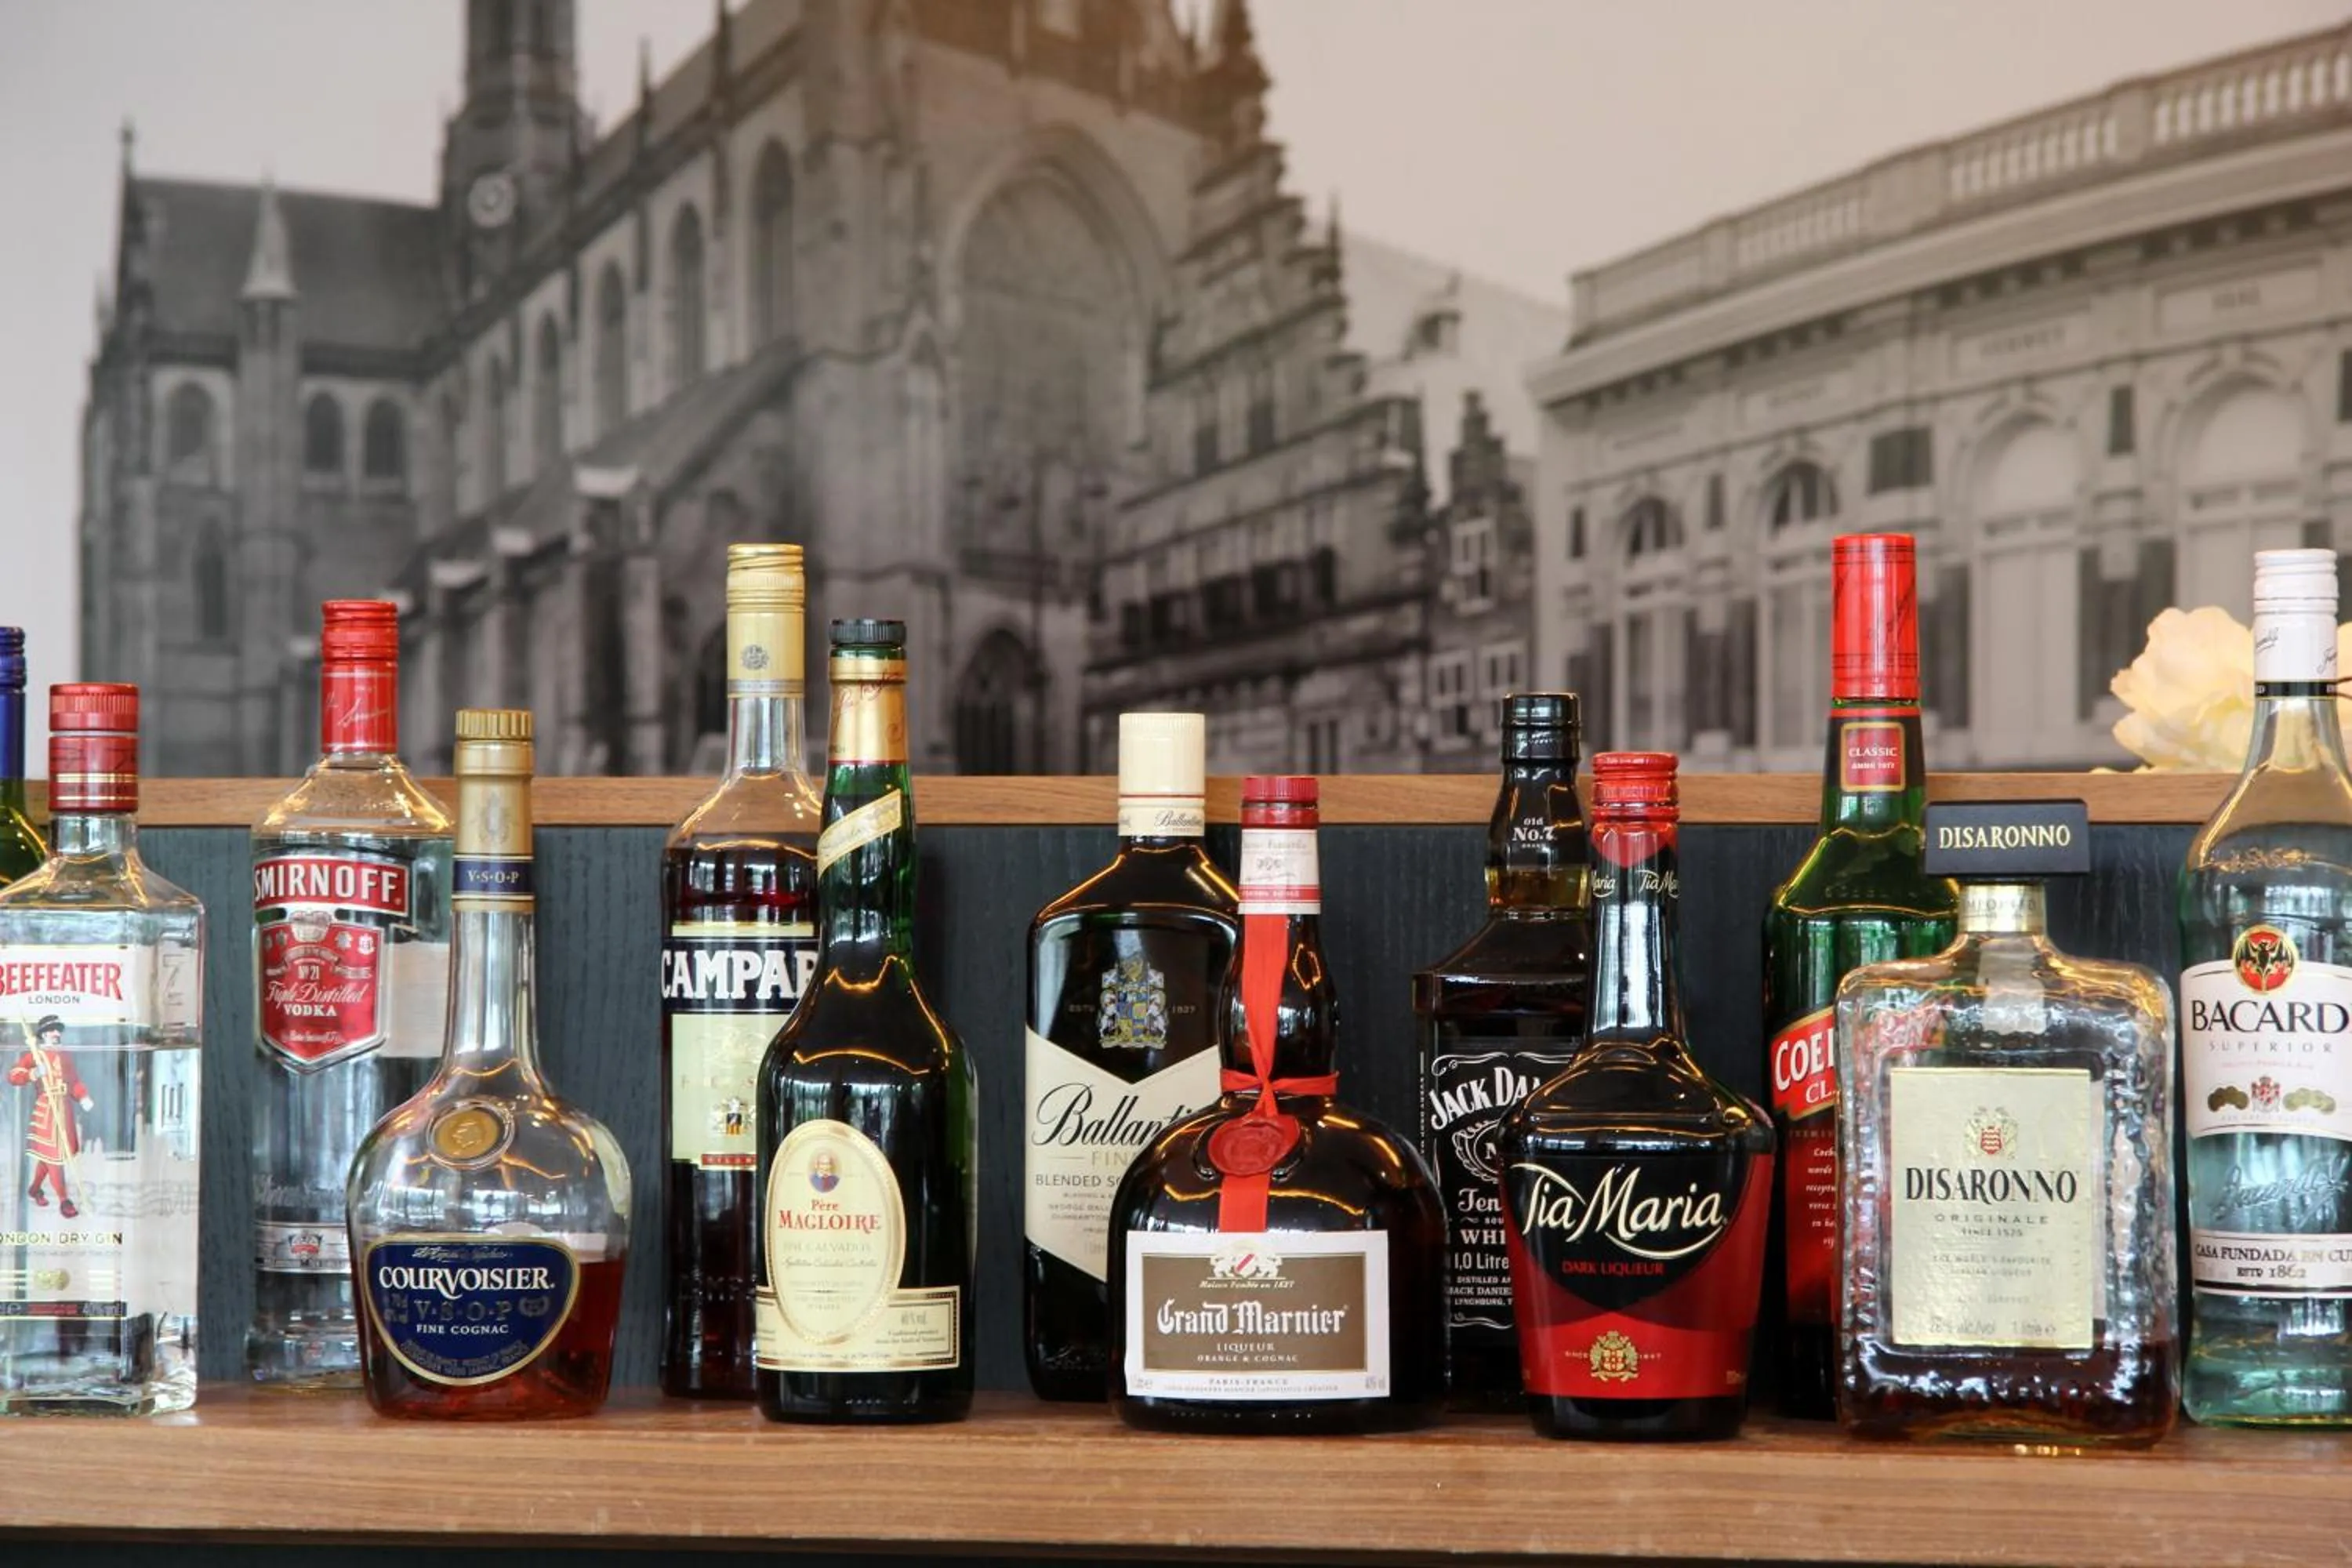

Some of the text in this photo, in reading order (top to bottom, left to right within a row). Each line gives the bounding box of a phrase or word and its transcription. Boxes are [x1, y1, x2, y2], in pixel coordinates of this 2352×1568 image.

[1849, 746, 1898, 757] CLASSIC
[1939, 825, 2071, 850] DISARONNO
[255, 863, 398, 903] SMIRNOFF
[1635, 869, 1659, 893] Tia
[27, 995, 81, 1004] LONDON
[294, 982, 369, 1003] Distilled
[284, 1004, 336, 1017] VODKA
[2191, 1000, 2352, 1033] BACARD
[2209, 1042, 2332, 1053] SUPERIOR
[1428, 1077, 1493, 1130] JACK
[1092, 1151, 1137, 1166] FIN
[1036, 1174, 1102, 1187] BLENDED
[1906, 1167, 2078, 1205] DISARONNO
[1457, 1188, 1502, 1212] Ten
[1510, 1163, 1724, 1248] Tia Maria
[779, 1210, 882, 1235] MAGLOIRE
[1934, 1214, 2049, 1225] ORIGINALE
[0, 1232, 123, 1245] NDON DRY GIN
[2196, 1243, 2218, 1258] CASA
[2221, 1247, 2297, 1261] FUNDADA
[1476, 1252, 1509, 1270] Litre
[1562, 1261, 1665, 1276] DARK LIQUEUR
[1457, 1276, 1499, 1284] DISTILLED
[1157, 1298, 1346, 1334] Grand Marnier
[416, 1324, 509, 1335] FINE COGNAC
[1216, 1342, 1276, 1353] LIQUEUR
[1197, 1354, 1238, 1363] ORANGE
